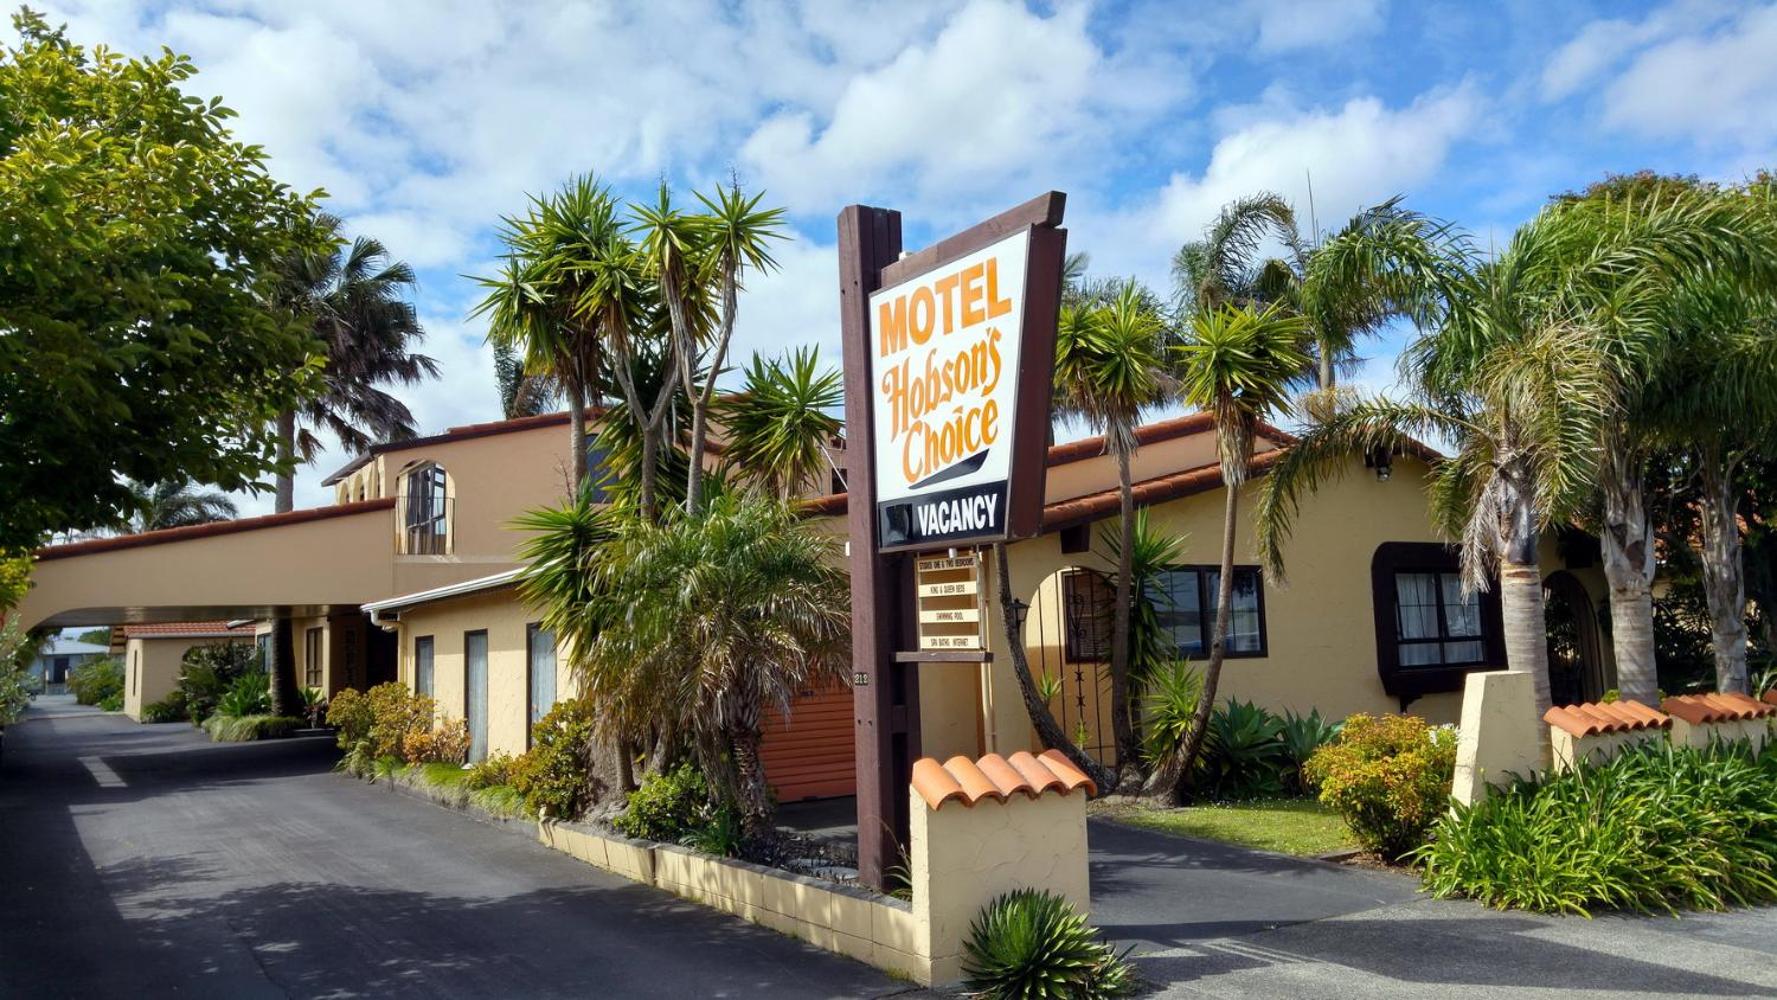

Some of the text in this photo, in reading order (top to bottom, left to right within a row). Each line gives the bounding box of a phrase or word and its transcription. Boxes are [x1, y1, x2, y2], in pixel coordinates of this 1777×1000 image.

[879, 256, 1012, 358] MOTEL
[881, 326, 1001, 443] Hobson's
[902, 398, 998, 484] Choice
[917, 493, 998, 537] VACANCY
[936, 611, 963, 621] SWIMMING POOL
[944, 584, 955, 594] QUEEN
